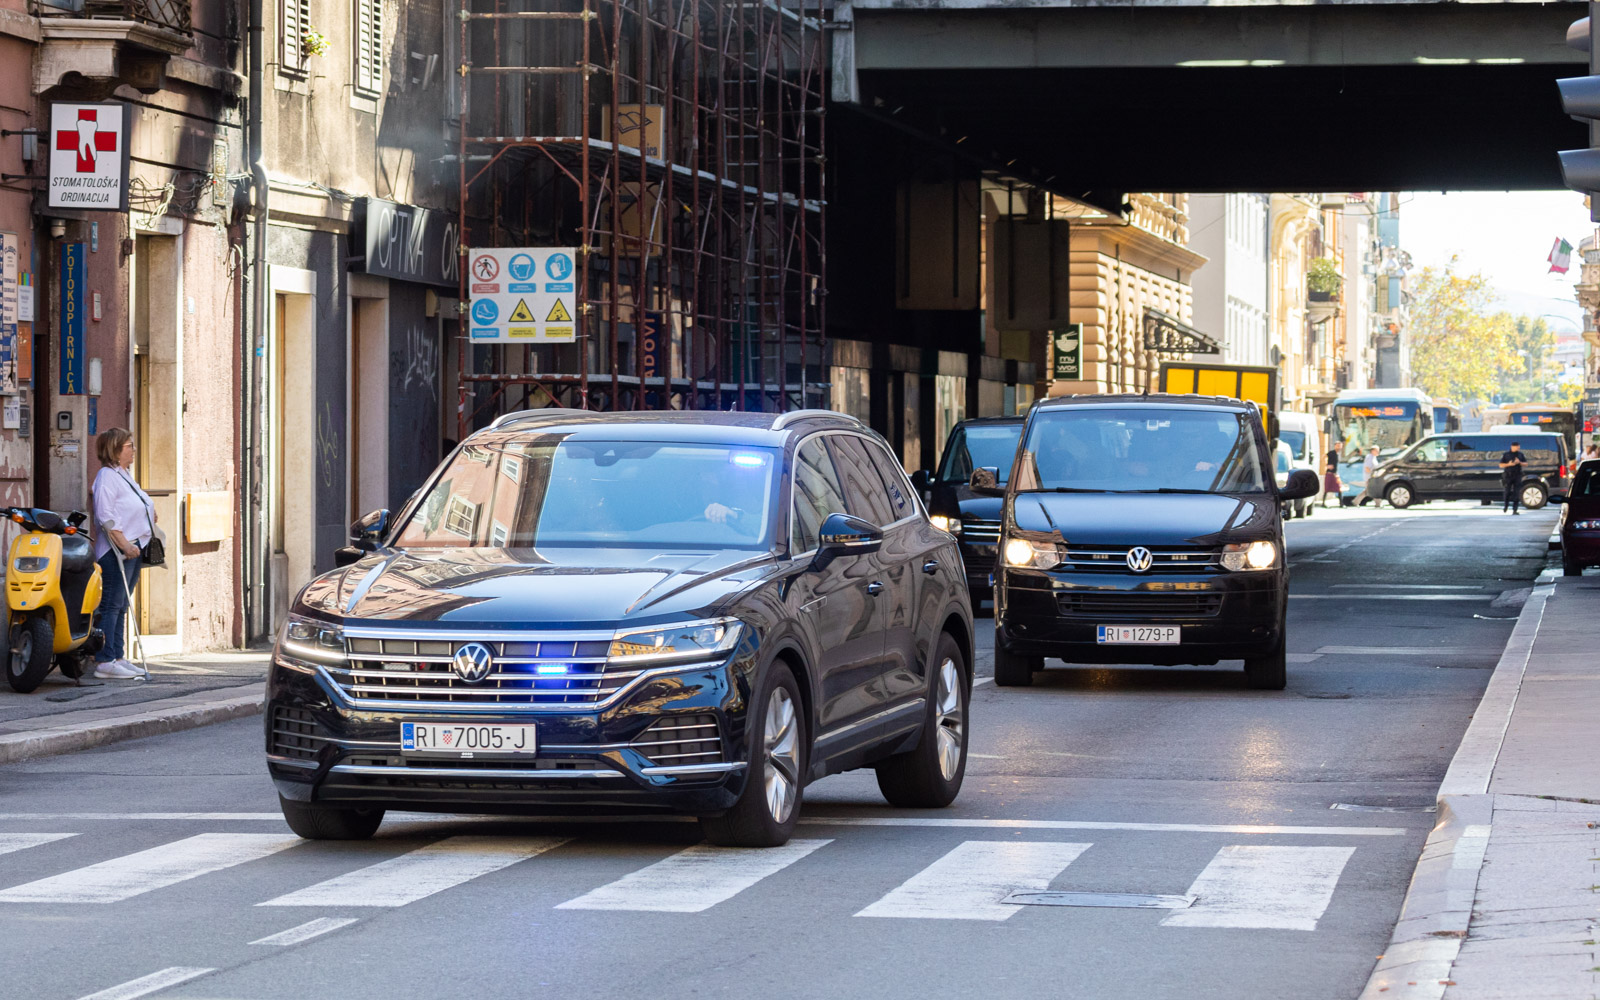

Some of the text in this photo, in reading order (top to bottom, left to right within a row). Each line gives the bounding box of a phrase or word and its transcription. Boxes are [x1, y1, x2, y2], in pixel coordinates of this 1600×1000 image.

[52, 176, 119, 188] STOMATOLOŠKA
[60, 191, 110, 203] ORDINACIJA
[378, 207, 425, 277] OPTIKA
[66, 244, 75, 395] FOTOKOPIRNICA
[1106, 628, 1175, 641] RI 1279-P
[416, 726, 526, 749] RI 7005-J
